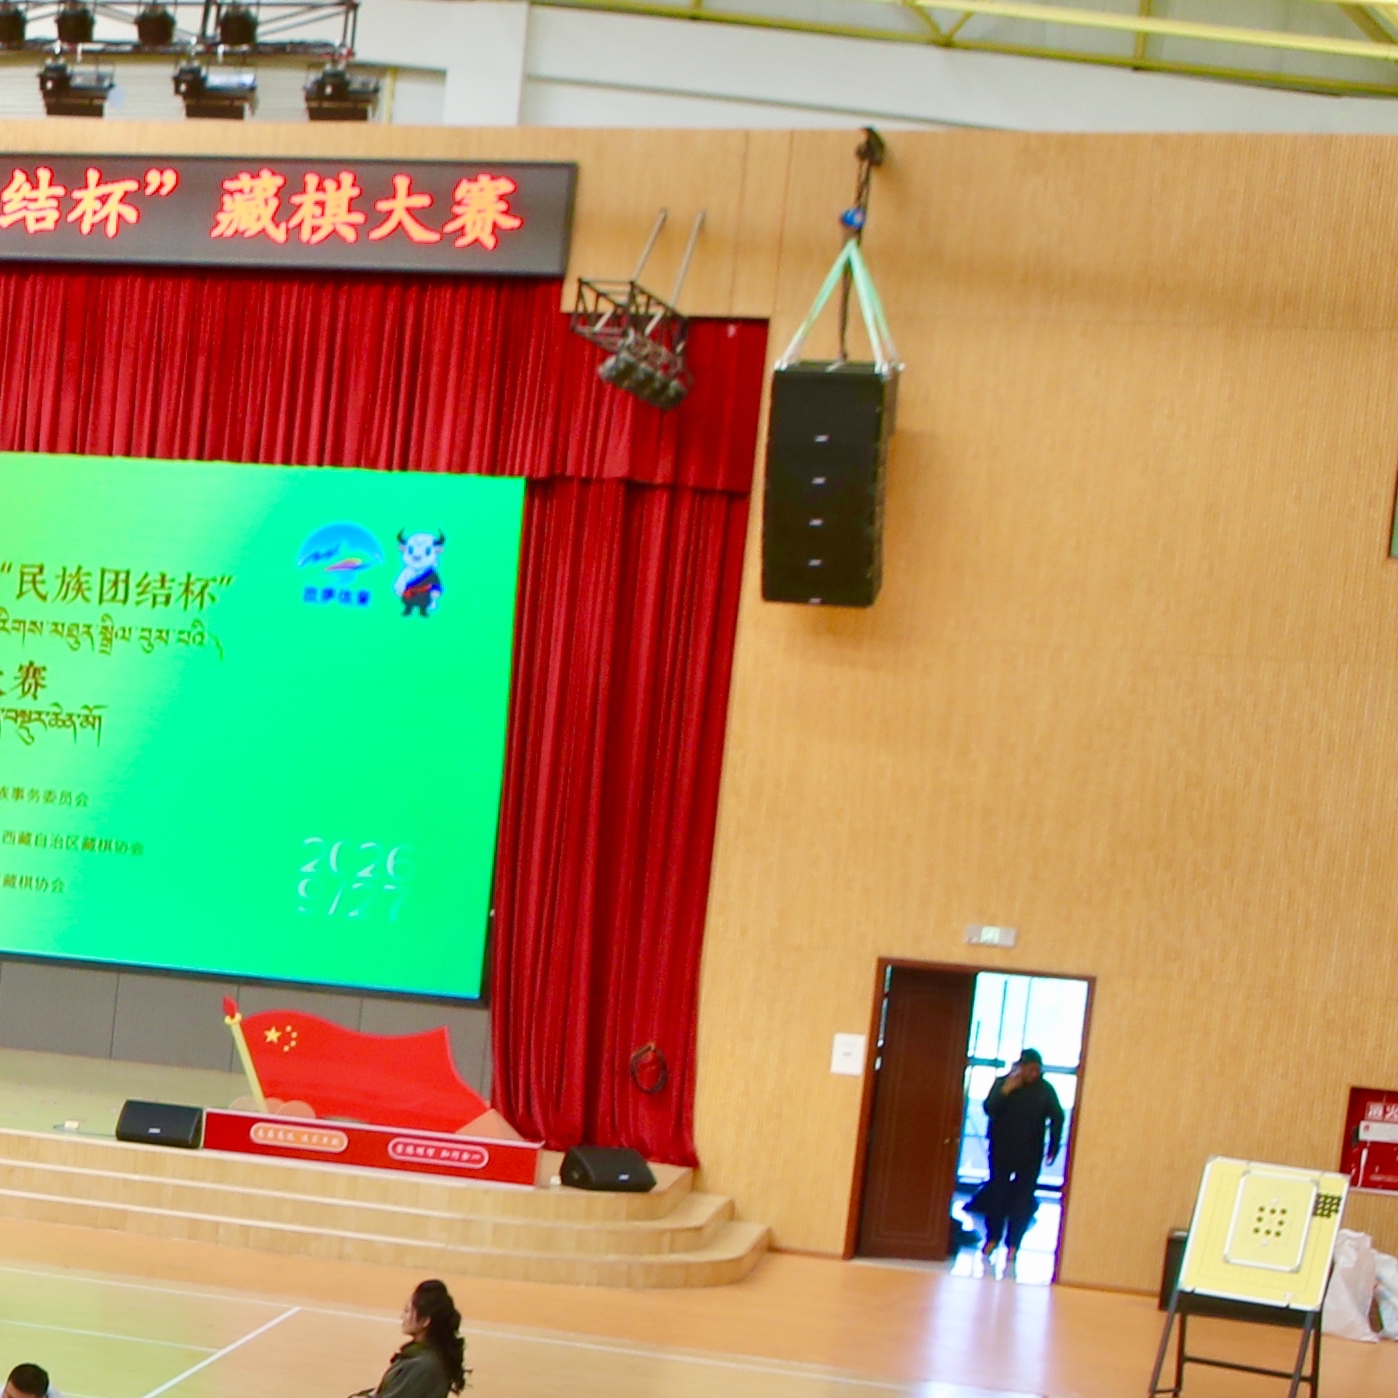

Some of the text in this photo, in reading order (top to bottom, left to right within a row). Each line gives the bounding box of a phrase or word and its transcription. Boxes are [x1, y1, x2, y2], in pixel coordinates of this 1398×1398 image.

[210, 173, 523, 252] 藏棋大赛
[300, 836, 415, 881] 2026
